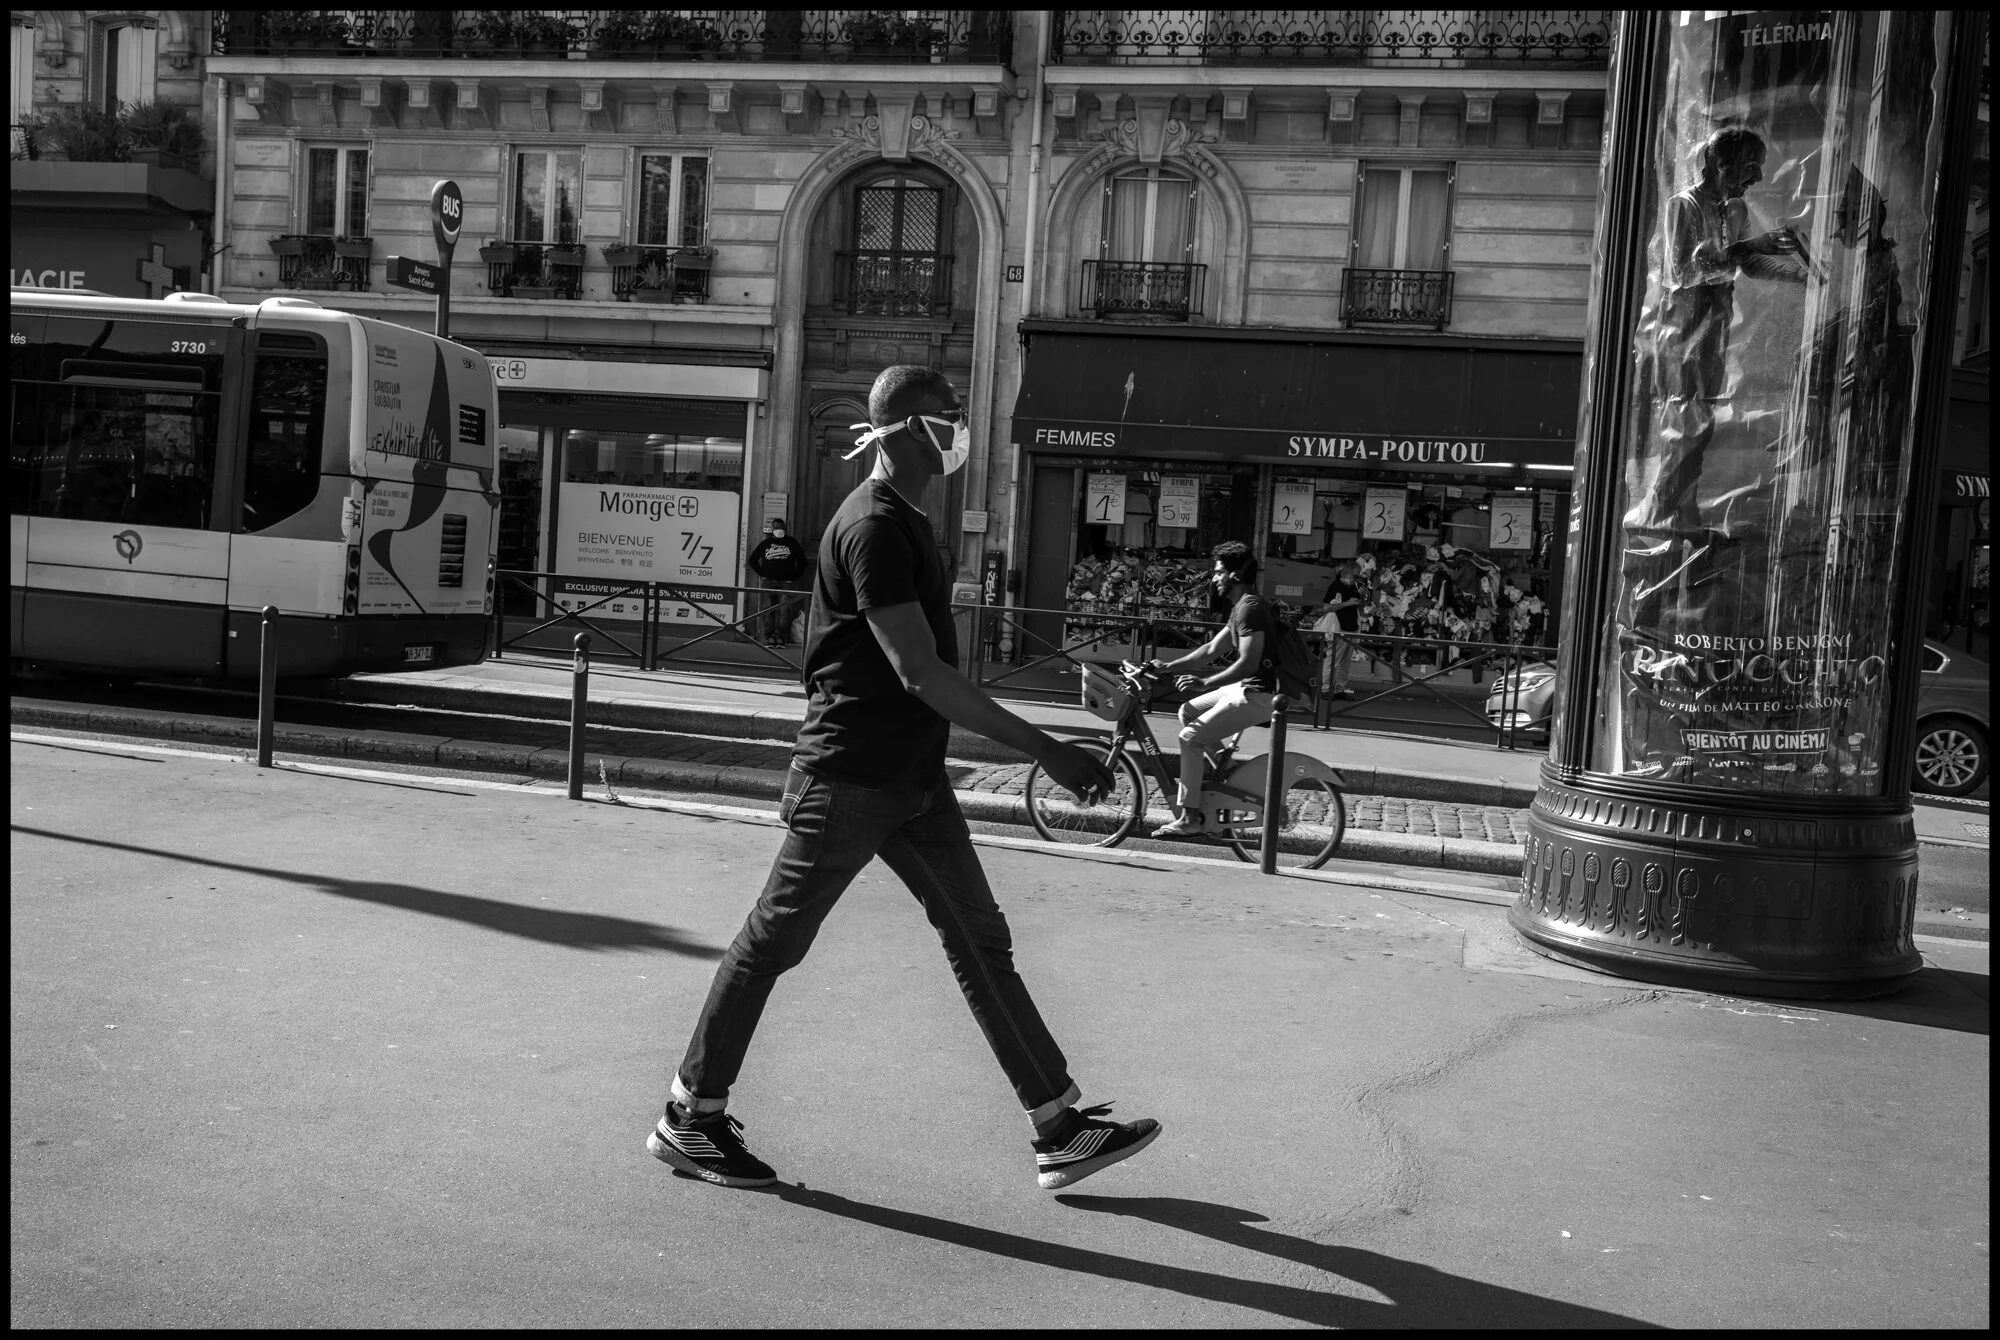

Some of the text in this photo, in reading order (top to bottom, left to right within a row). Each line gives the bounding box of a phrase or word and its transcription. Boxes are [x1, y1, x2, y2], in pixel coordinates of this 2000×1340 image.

[1740, 22, 1832, 47] TÉLÉRAMA
[442, 195, 460, 218] BUS
[11, 269, 85, 289] ACIE
[414, 266, 430, 277] Anvers
[1009, 267, 1022, 280] 68
[171, 341, 206, 354] 3730
[1035, 428, 1116, 447] FEMMES
[1288, 436, 1485, 463] SYMPA-POUTOU
[1170, 479, 1194, 492] SYMPA
[1285, 484, 1309, 493] SYMPA
[623, 492, 675, 500] PARAPHARMACIE
[599, 491, 675, 522] Monge
[578, 532, 654, 547] BIENVENUE
[615, 549, 653, 557] BENVENUTO
[681, 531, 714, 565] 7/7
[679, 568, 692, 576] 10H
[698, 569, 713, 577] 20H
[565, 583, 608, 592] EXCLUSIVE
[690, 591, 723, 600] REFUND
[1674, 631, 1851, 651] ROBERTO BENIGNI
[1679, 702, 1700, 712] FILM
[1704, 704, 1717, 712] DE
[1721, 701, 1780, 712] MATTEO
[1687, 730, 1825, 750] BIENTÔT AU CINÉMA
